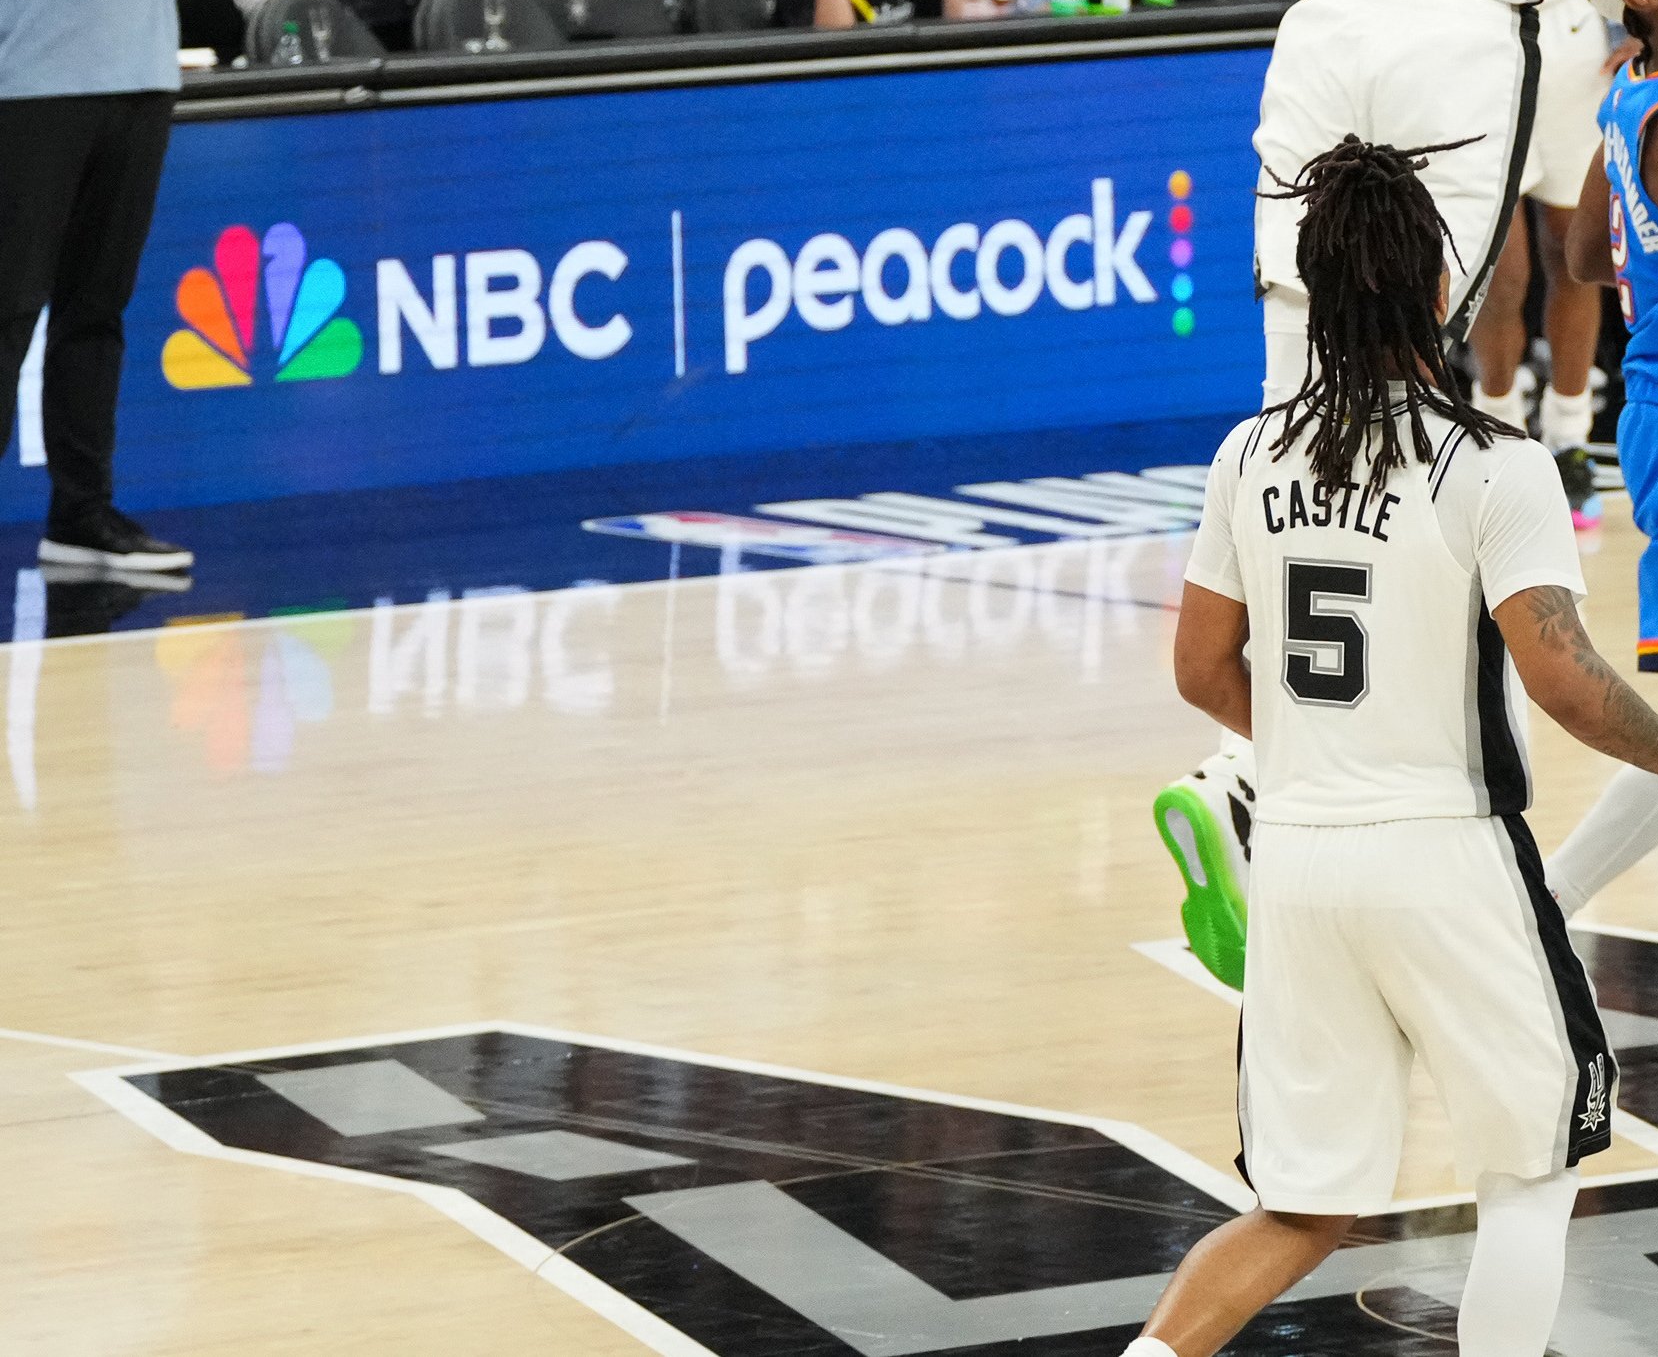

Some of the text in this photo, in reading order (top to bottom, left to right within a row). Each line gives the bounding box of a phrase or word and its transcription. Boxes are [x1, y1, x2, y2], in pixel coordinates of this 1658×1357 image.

[376, 177, 1158, 375] NBC peacock
[1262, 479, 1401, 542] CASTLE
[1280, 556, 1373, 710] 5
